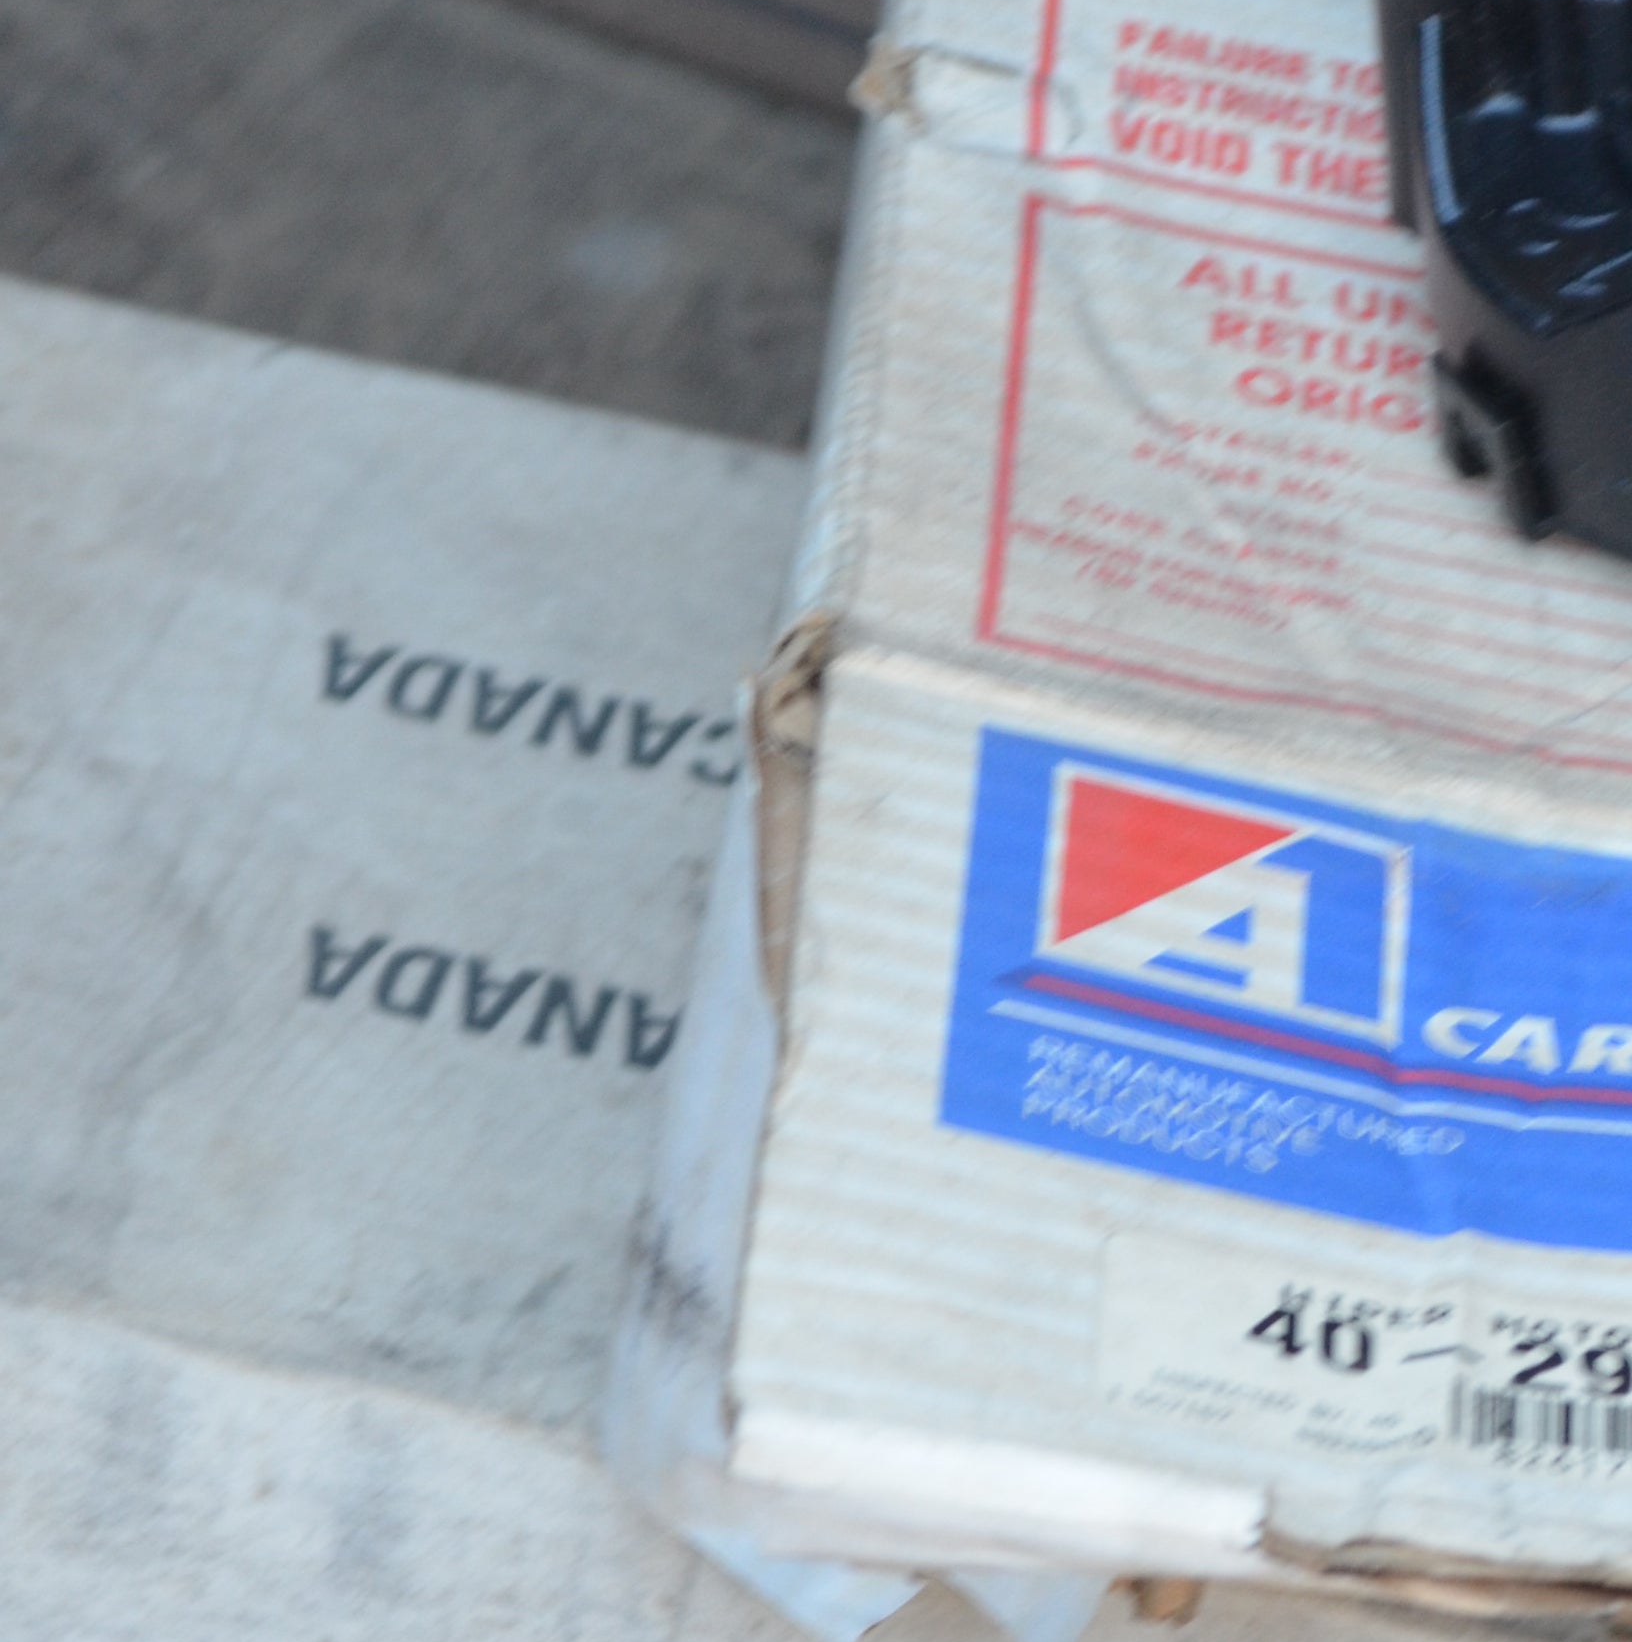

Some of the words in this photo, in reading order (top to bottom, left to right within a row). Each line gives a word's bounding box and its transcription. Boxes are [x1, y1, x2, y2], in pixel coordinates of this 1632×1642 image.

[1116, 19, 1311, 79] FAILURE
[1110, 110, 1250, 178] VOID
[1271, 138, 1390, 202] THE
[1180, 255, 1305, 310] ALL
[322, 631, 742, 787] CANADA
[304, 926, 687, 1070] ANADA
